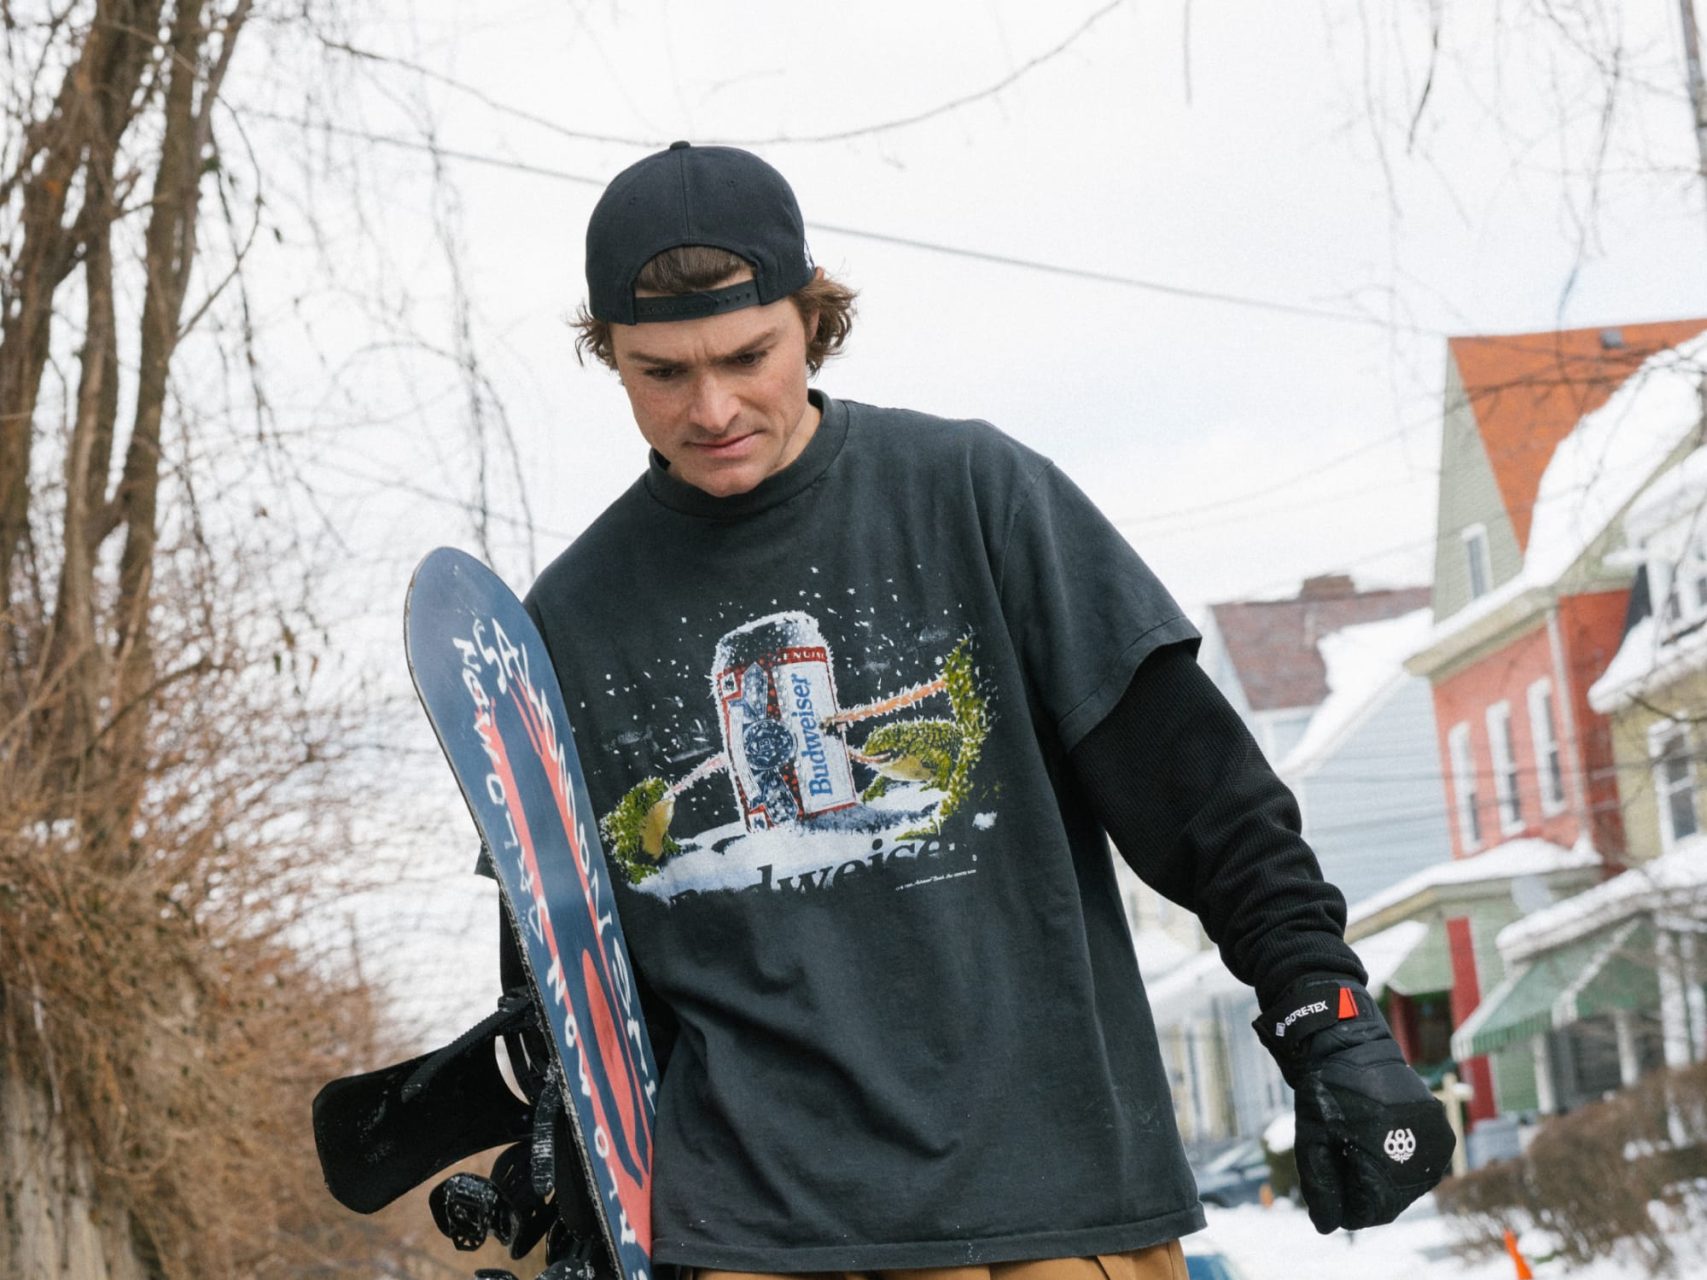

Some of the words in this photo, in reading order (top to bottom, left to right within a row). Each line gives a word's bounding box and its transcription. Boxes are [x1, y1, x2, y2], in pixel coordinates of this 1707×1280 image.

[791, 673, 833, 796] Budweiser
[1285, 1000, 1329, 1026] GORE-TEX
[1384, 1128, 1416, 1155] 686
